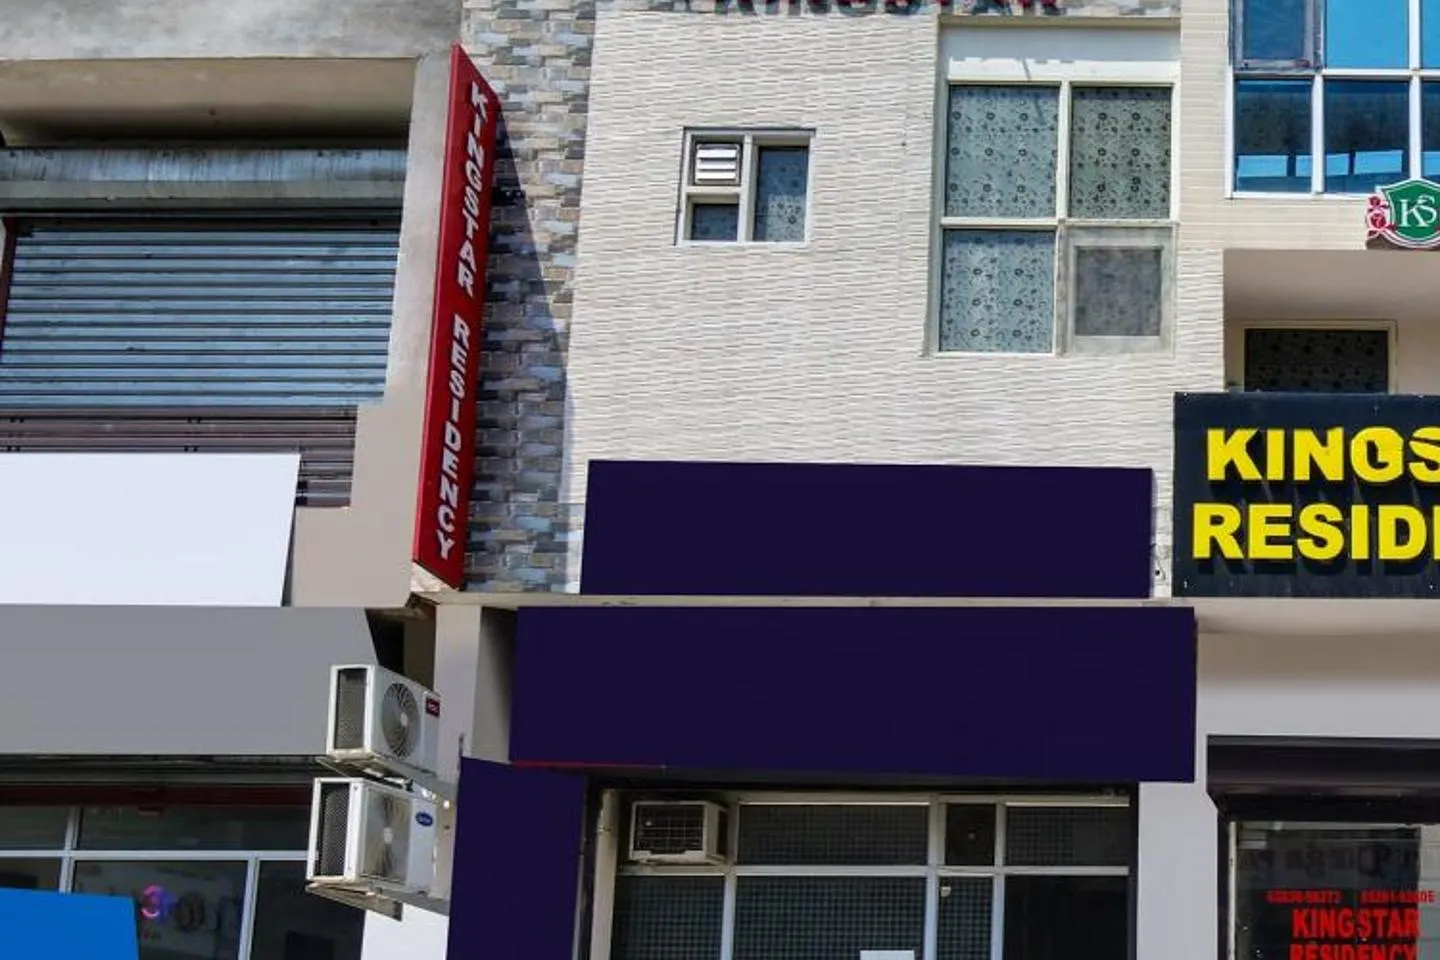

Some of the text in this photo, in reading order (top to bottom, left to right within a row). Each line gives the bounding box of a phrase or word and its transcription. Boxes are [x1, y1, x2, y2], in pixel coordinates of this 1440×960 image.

[436, 80, 489, 561] KINGSTAR RESIDENCY
[1292, 908, 1420, 938] KINGSTAR
